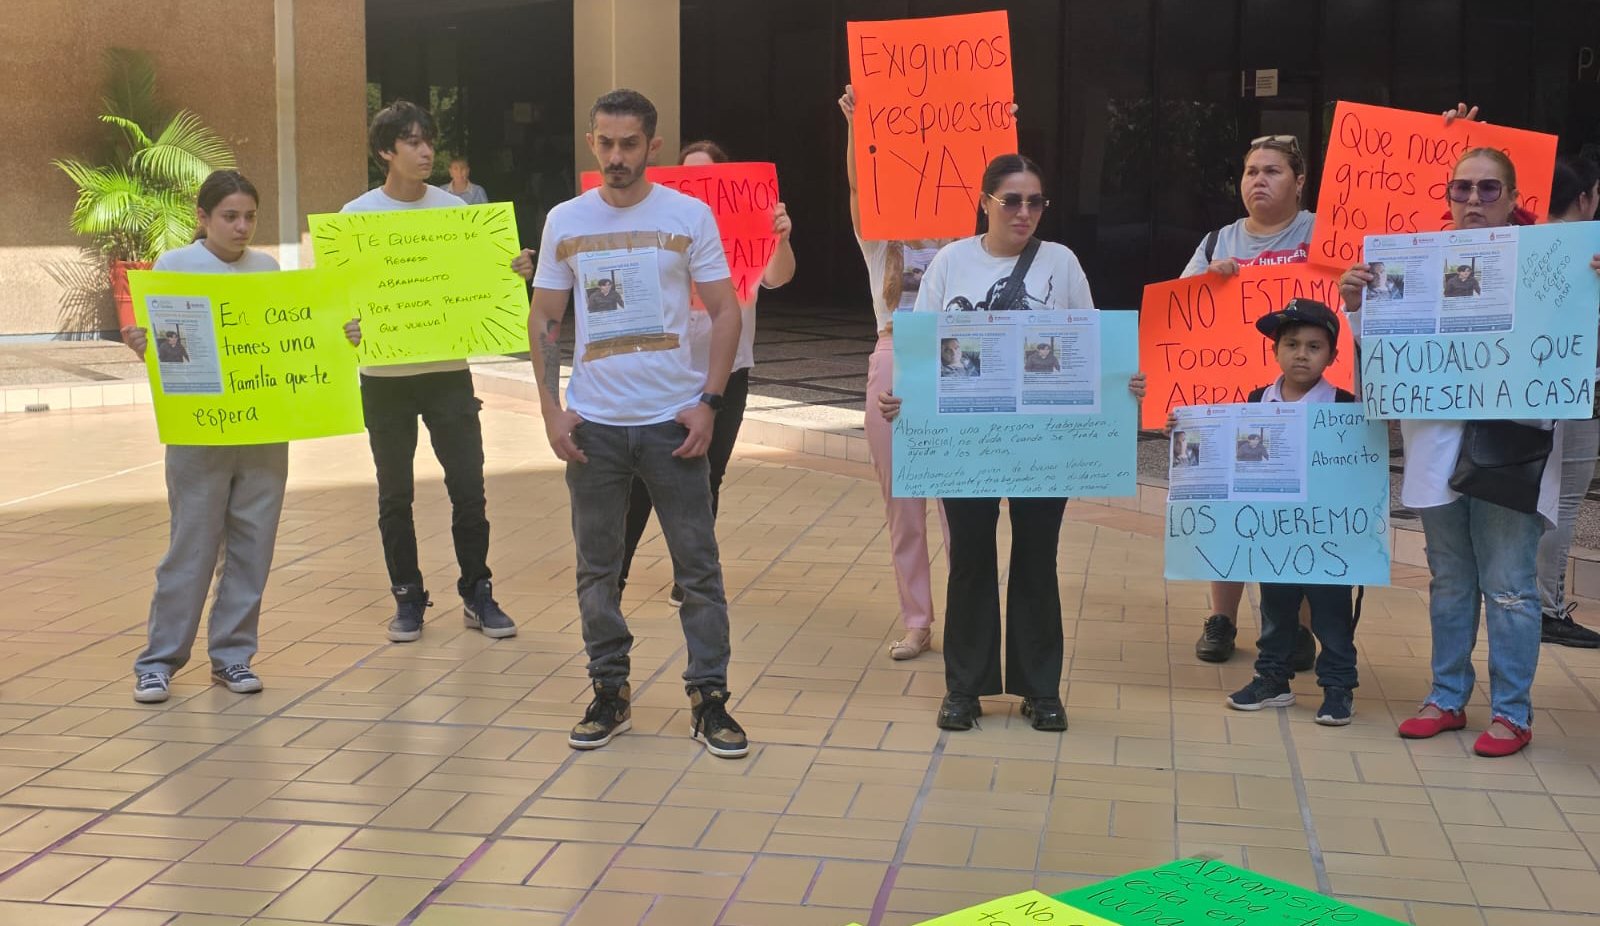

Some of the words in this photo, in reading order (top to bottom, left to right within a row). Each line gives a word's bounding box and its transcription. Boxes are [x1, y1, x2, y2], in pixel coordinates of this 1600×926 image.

[860, 35, 1008, 98] Exigimos
[868, 93, 1012, 145] respuestas
[1339, 111, 1393, 158] Que
[662, 177, 777, 215] STAMOS
[1335, 159, 1416, 205] gritos
[1332, 204, 1368, 231] no
[1385, 202, 1419, 234] los
[351, 233, 381, 252] TE
[388, 232, 458, 246] QUEREMOS
[464, 232, 479, 241] DE
[384, 256, 429, 266] REGRESO
[220, 302, 250, 328] En
[264, 304, 313, 326] casa
[368, 302, 391, 315] POR
[396, 300, 432, 310] FAVOR
[1168, 283, 1216, 332] NO
[1241, 277, 1341, 325] ESTAMO
[379, 323, 398, 333] QUE
[222, 335, 271, 357] tienes
[280, 334, 316, 354] una
[1155, 342, 1248, 372] TODOS
[1364, 337, 1511, 376] AYUDALOS
[1530, 334, 1585, 368] QUE
[1364, 381, 1486, 417] REGRESEN
[1496, 379, 1513, 408] A
[1525, 377, 1591, 408] CASA
[193, 405, 260, 434] espera
[894, 416, 949, 436] Abraham
[1072, 430, 1098, 440] trata
[1107, 428, 1121, 438] de
[955, 448, 970, 458] los
[1311, 445, 1380, 467] Abrancito
[1169, 504, 1217, 538] LOS
[1234, 504, 1387, 542] QUEREMOS
[1194, 541, 1350, 579] VIVOS
[1123, 878, 1189, 907] esta
[1015, 900, 1055, 922] No
